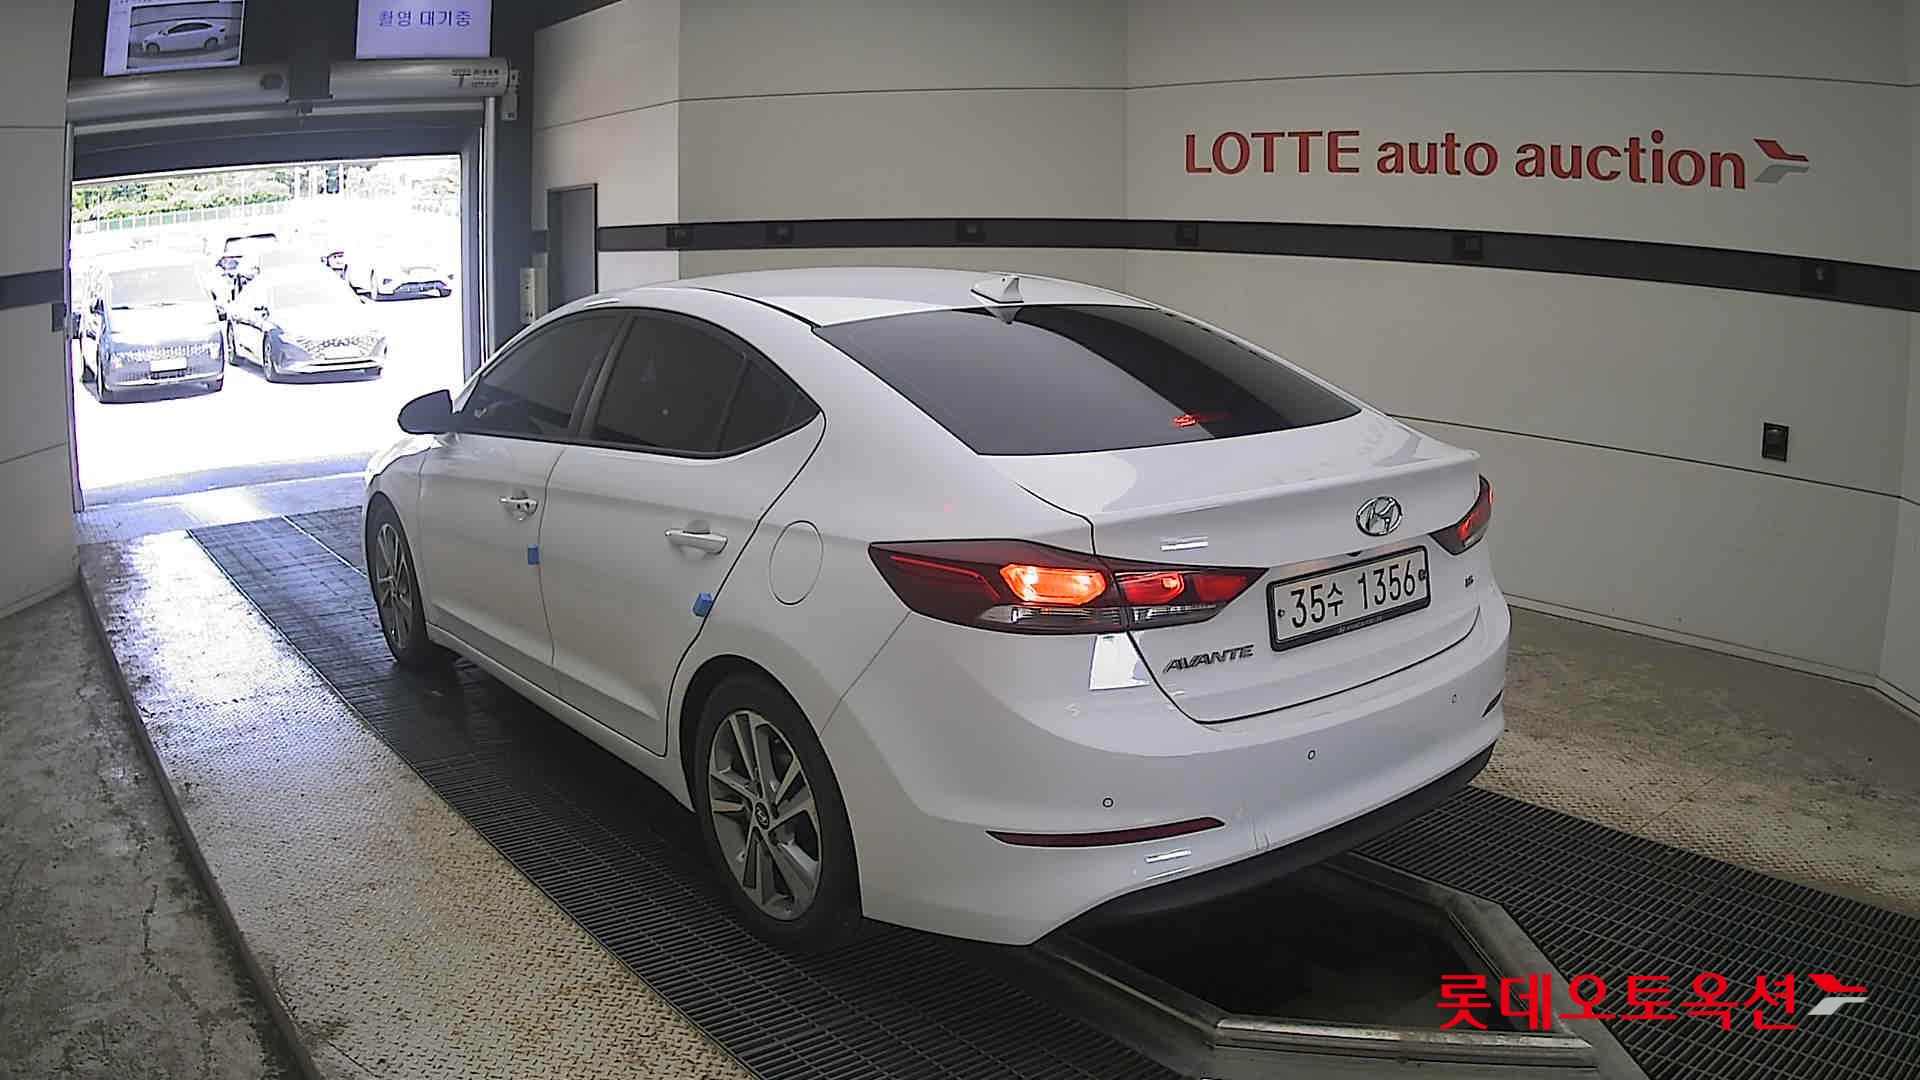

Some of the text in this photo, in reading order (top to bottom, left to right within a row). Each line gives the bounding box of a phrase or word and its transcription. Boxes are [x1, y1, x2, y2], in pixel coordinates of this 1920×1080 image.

[420, 9, 473, 27] 대기중
[1185, 130, 1747, 189] LOTTE auto auction
[1290, 559, 1415, 629] 35수 1356
[1163, 643, 1255, 673] AVANTE
